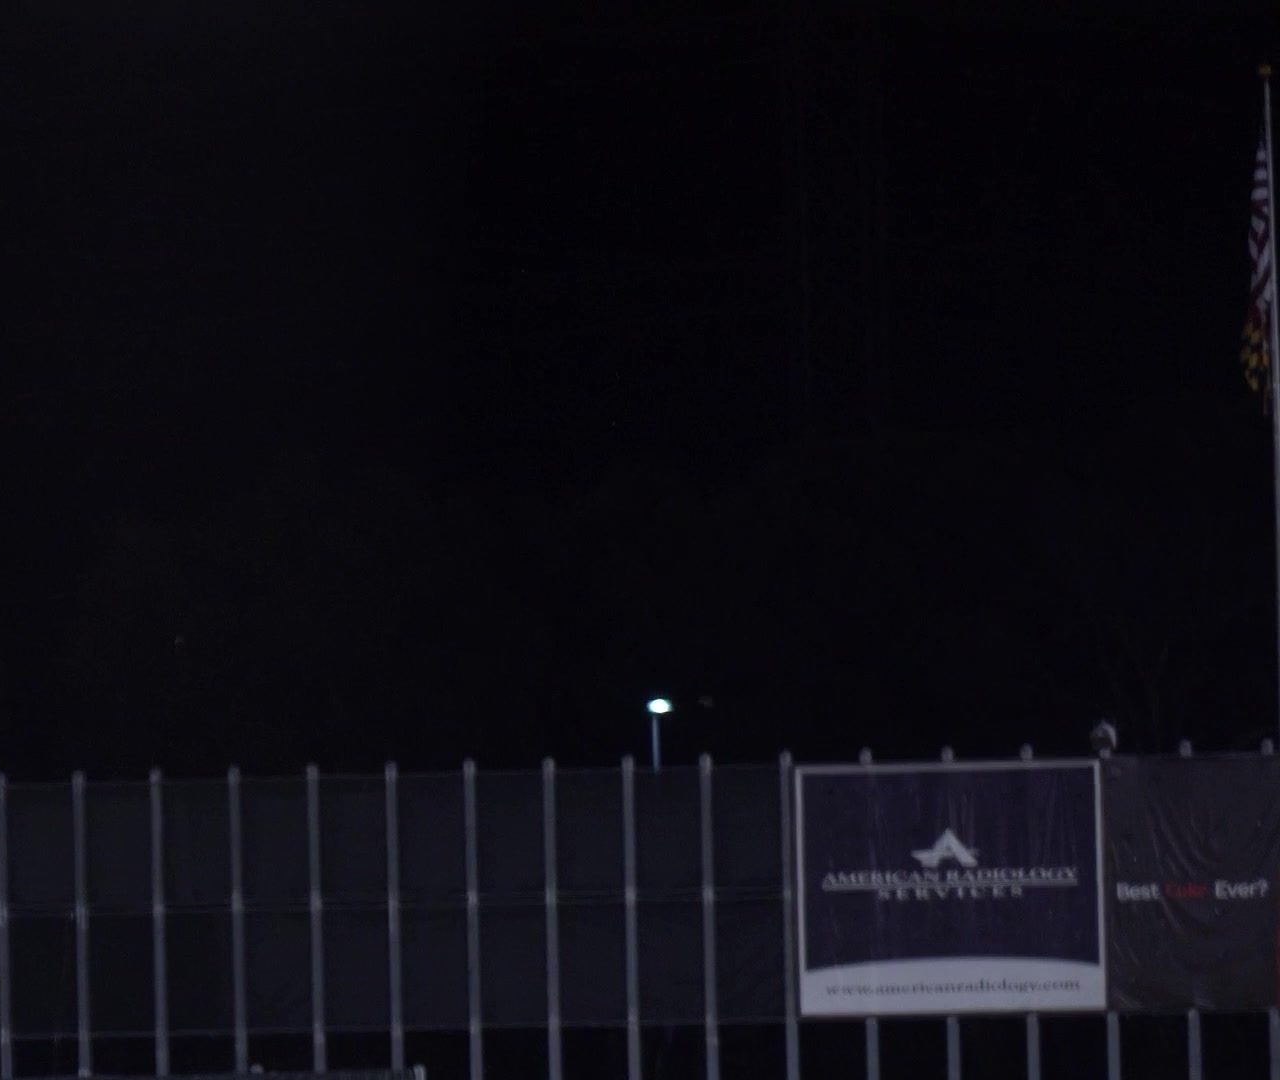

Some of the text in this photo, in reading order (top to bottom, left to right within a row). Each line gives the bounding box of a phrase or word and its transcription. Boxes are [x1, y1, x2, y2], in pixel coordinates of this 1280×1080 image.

[824, 867, 1078, 886] AMERICAN RADIOLOGY
[878, 886, 1024, 901] SERVICES
[1116, 882, 1160, 901] Best
[1215, 878, 1269, 900] Ever?
[826, 978, 1080, 996] www.americanradiology.com
